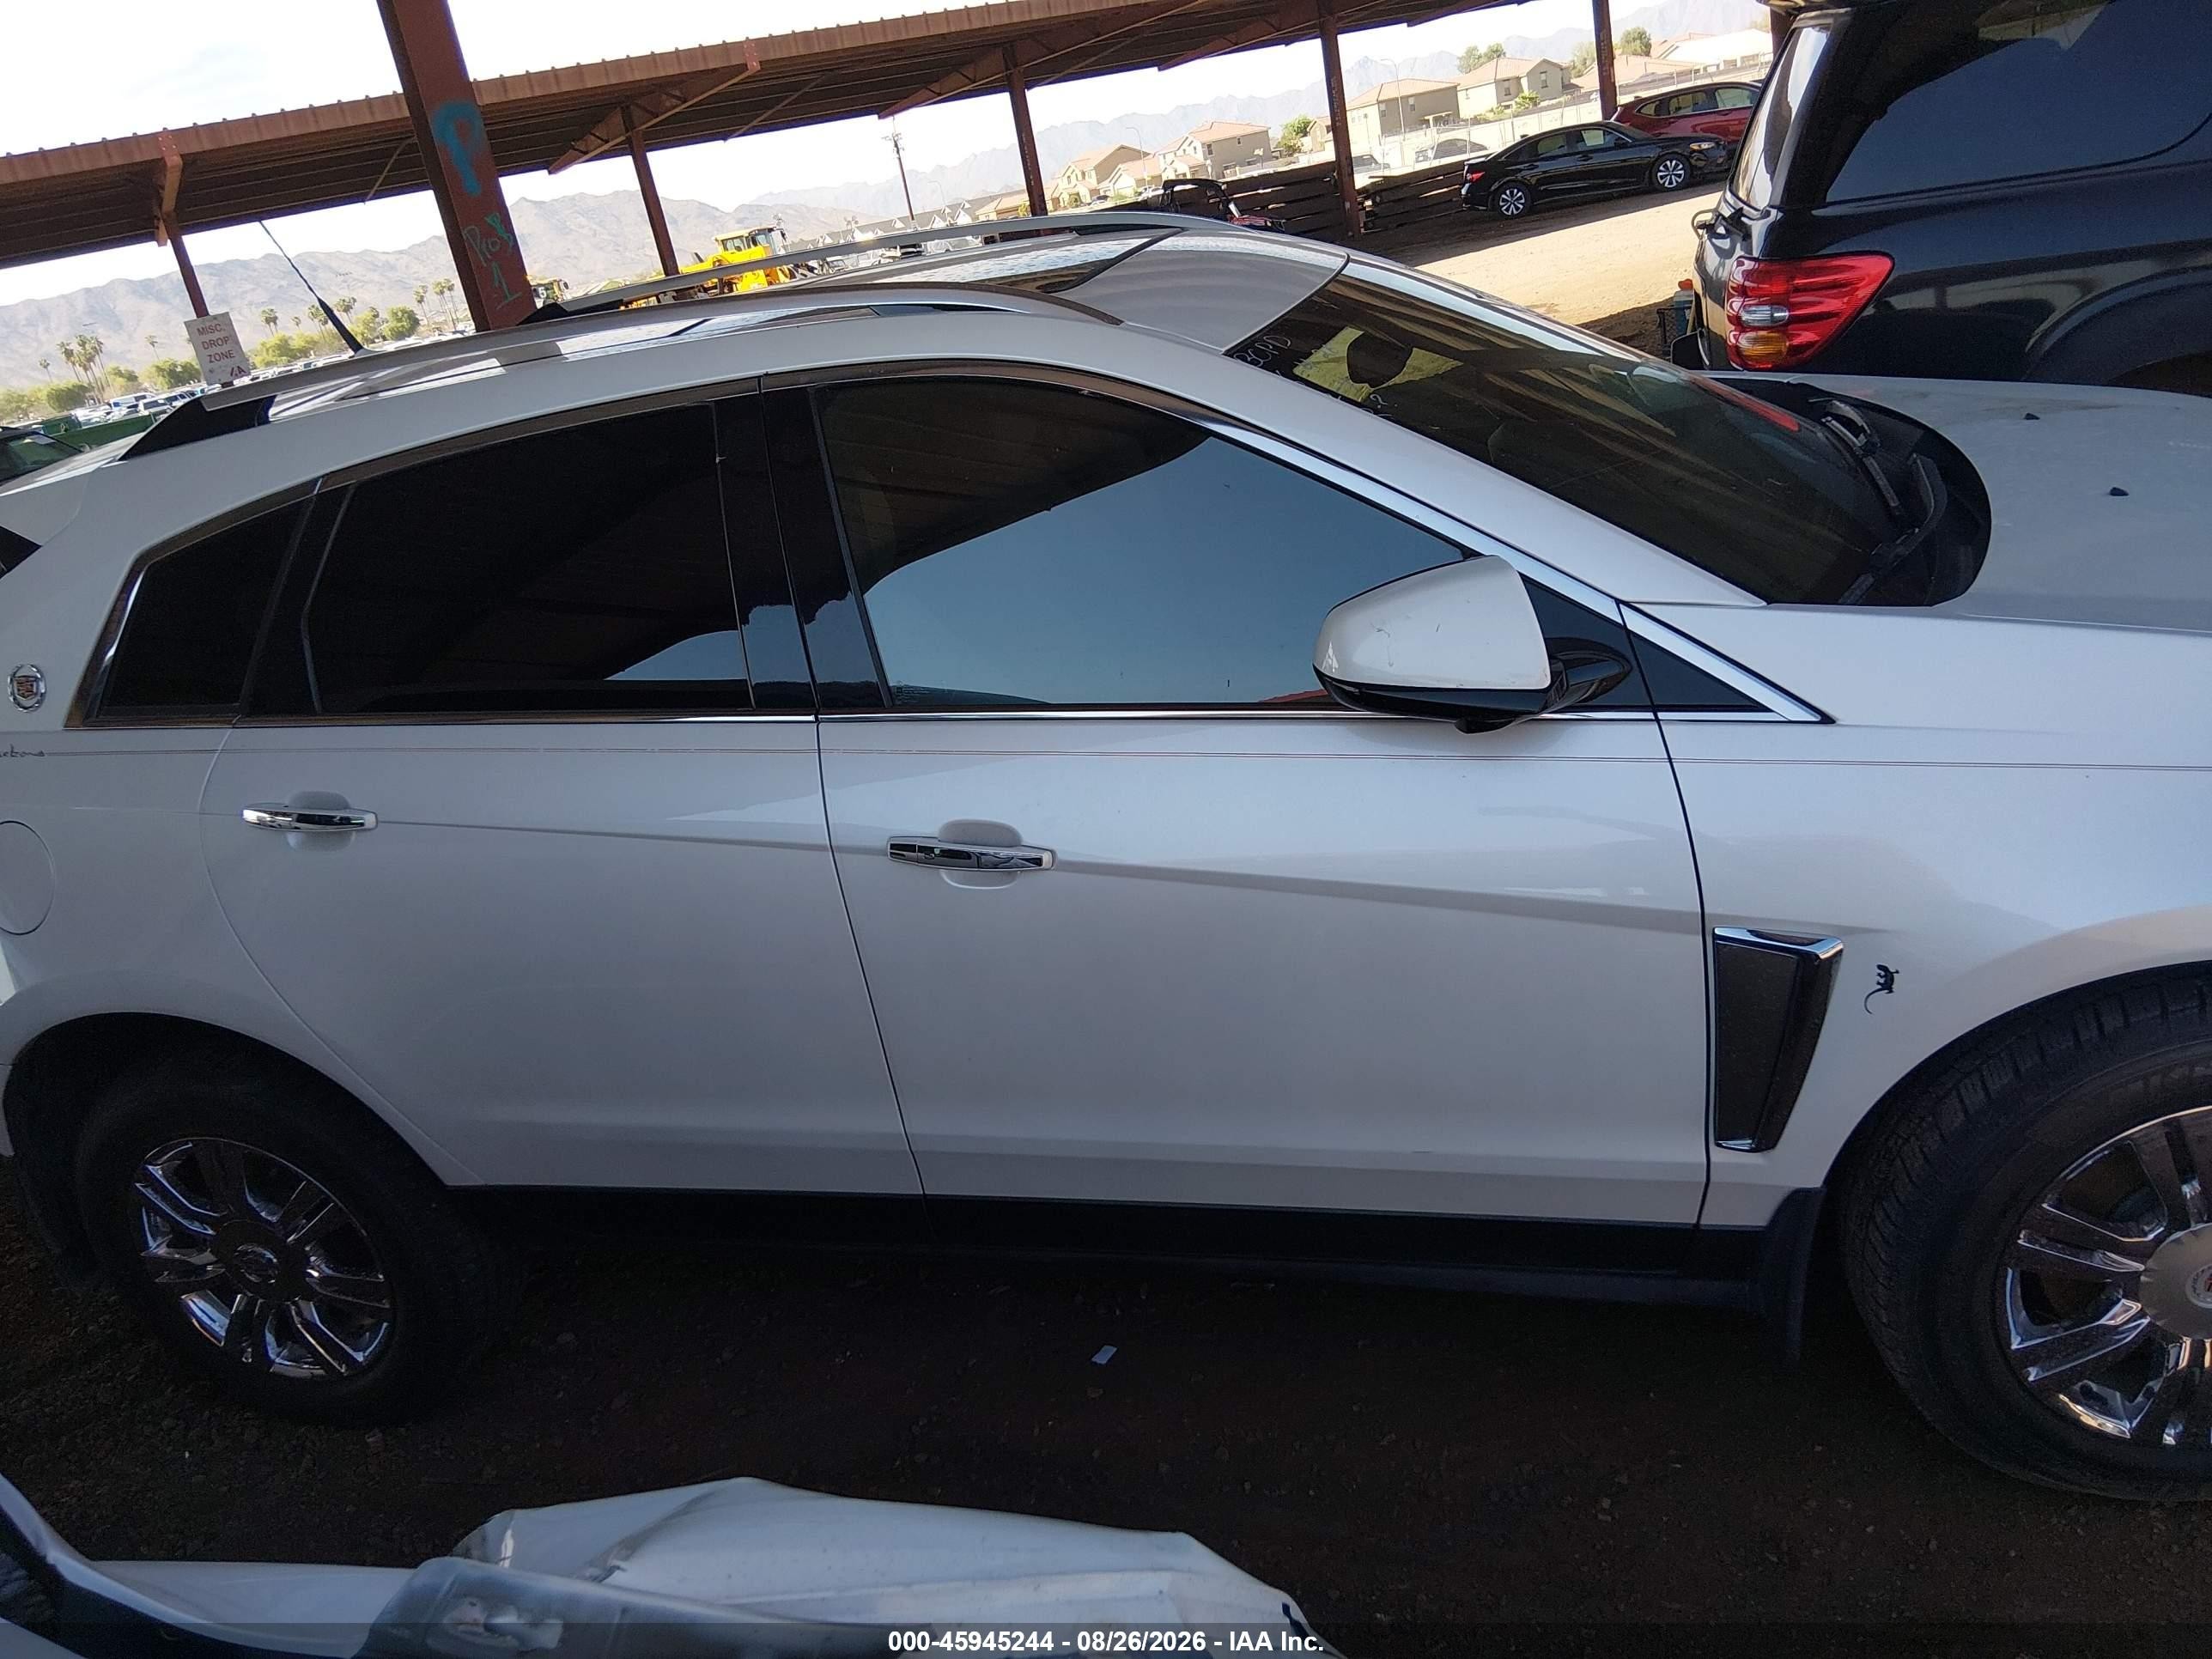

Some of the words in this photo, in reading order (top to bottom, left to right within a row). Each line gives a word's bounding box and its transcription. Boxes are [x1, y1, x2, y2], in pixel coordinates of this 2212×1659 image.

[197, 323, 226, 336] MISC.
[201, 336, 230, 349] DROP
[207, 349, 236, 363] ZONE
